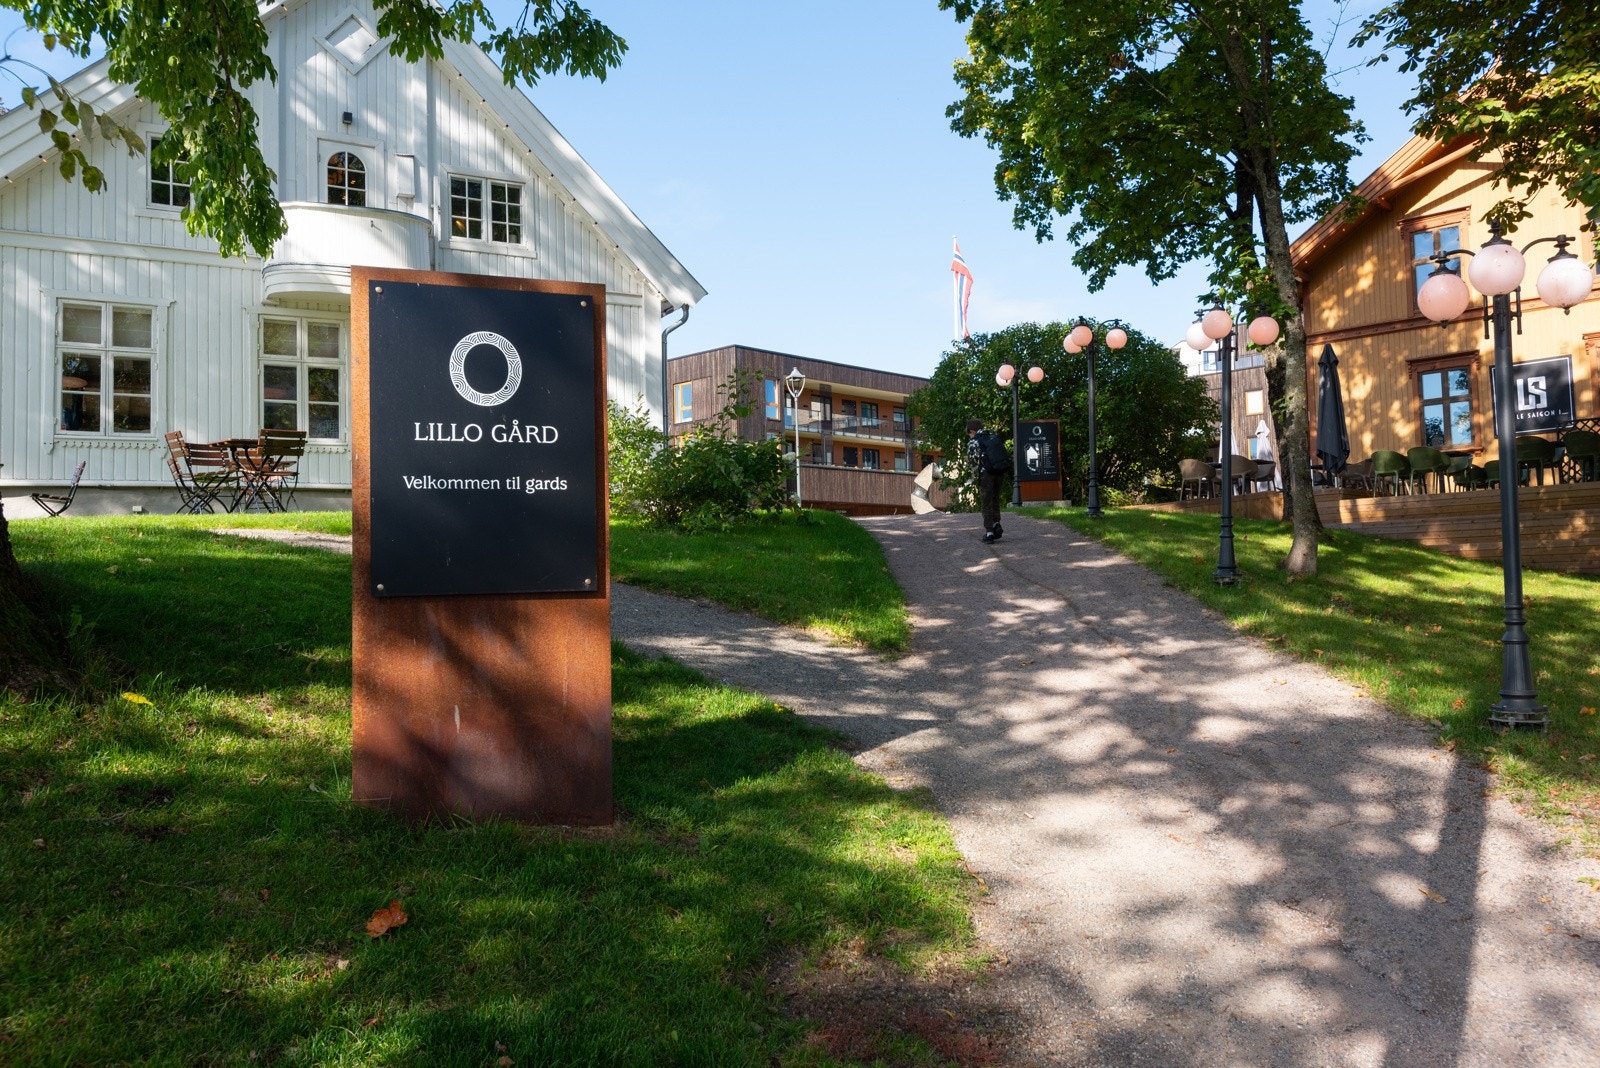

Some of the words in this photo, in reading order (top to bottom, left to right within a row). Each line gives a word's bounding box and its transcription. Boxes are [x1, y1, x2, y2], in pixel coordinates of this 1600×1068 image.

[1517, 377, 1547, 411] LS
[1527, 410, 1555, 419] SAIGON
[414, 422, 483, 443] LILLO
[491, 419, 559, 444] GÅRD
[402, 475, 500, 490] Velkommen
[506, 476, 520, 490] til
[525, 477, 568, 494] gards
